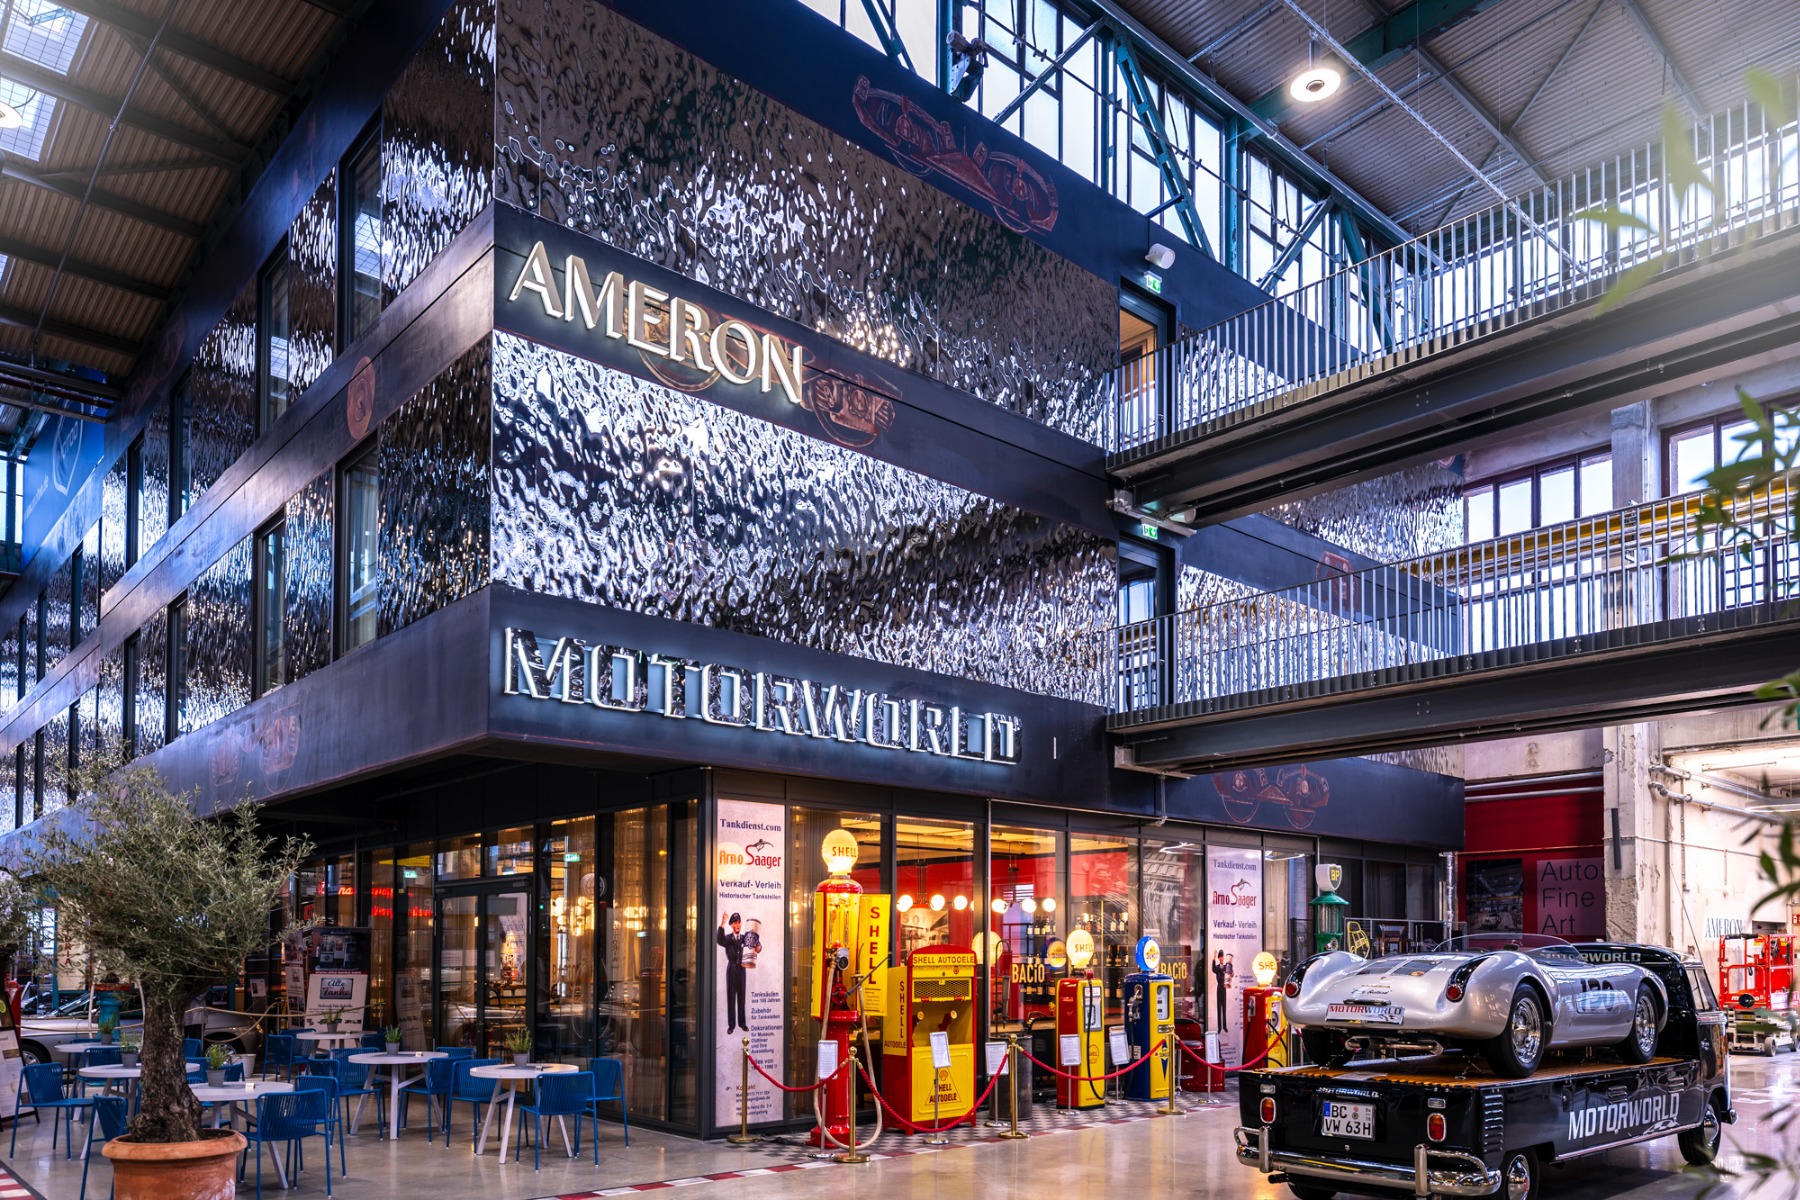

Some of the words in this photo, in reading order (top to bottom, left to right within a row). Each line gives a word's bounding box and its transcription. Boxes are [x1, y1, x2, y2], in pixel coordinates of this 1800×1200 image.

[508, 240, 802, 404] AMERON
[504, 626, 1023, 765] MOTORWORLD
[720, 818, 782, 832] Tankdienst.com
[720, 850, 744, 865] Arno
[745, 844, 782, 869] Saager
[832, 846, 857, 858] SHELL
[1213, 859, 1257, 871] Tankdienst.com
[1540, 860, 1604, 882] Auto
[1330, 870, 1340, 881] BP
[754, 880, 782, 890] Verleih
[719, 892, 752, 900] Historischer
[1212, 890, 1230, 906] Arno
[1231, 884, 1257, 908] Saager
[1542, 888, 1595, 908] Fine
[1238, 920, 1258, 929] Verleih
[1541, 914, 1576, 935] Art
[868, 906, 881, 985] SHELL
[913, 956, 936, 964] SHELL
[938, 956, 974, 964] AUTOOELE
[1329, 1004, 1402, 1016] MOTORWORLD
[884, 1041, 907, 1049] AUTOOELE
[1331, 1105, 1348, 1118] BC
[1568, 1092, 1680, 1141] MOTORWORLD
[1324, 1118, 1341, 1132] VW
[1346, 1120, 1371, 1136] 63H
